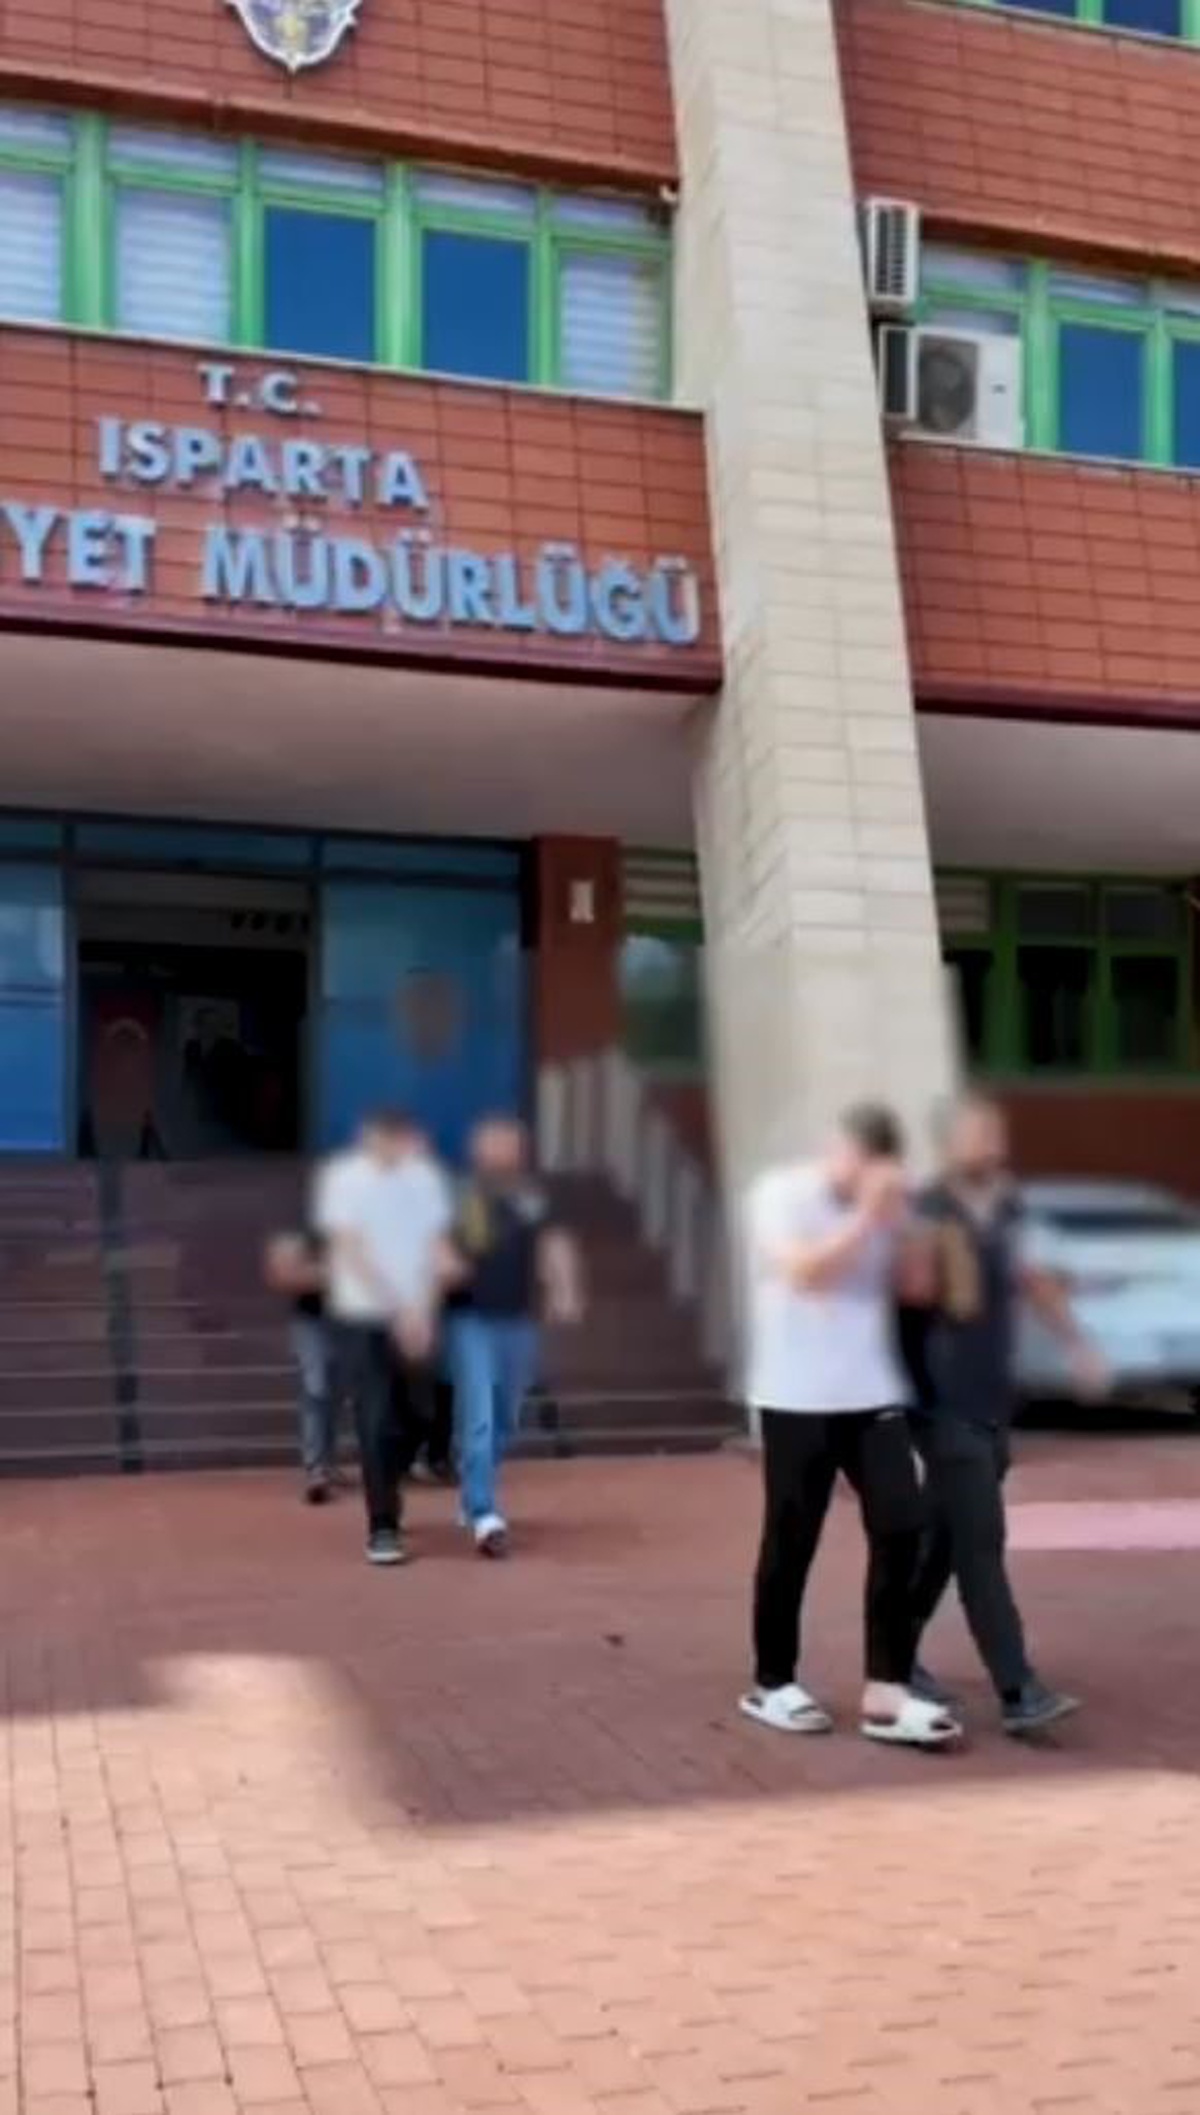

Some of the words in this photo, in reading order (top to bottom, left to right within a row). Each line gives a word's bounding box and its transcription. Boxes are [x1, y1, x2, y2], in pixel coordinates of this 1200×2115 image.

[198, 363, 321, 416] T.C.
[98, 416, 429, 511] ISPARTA
[204, 516, 701, 646] MÜDÜRLÜĞÜ
